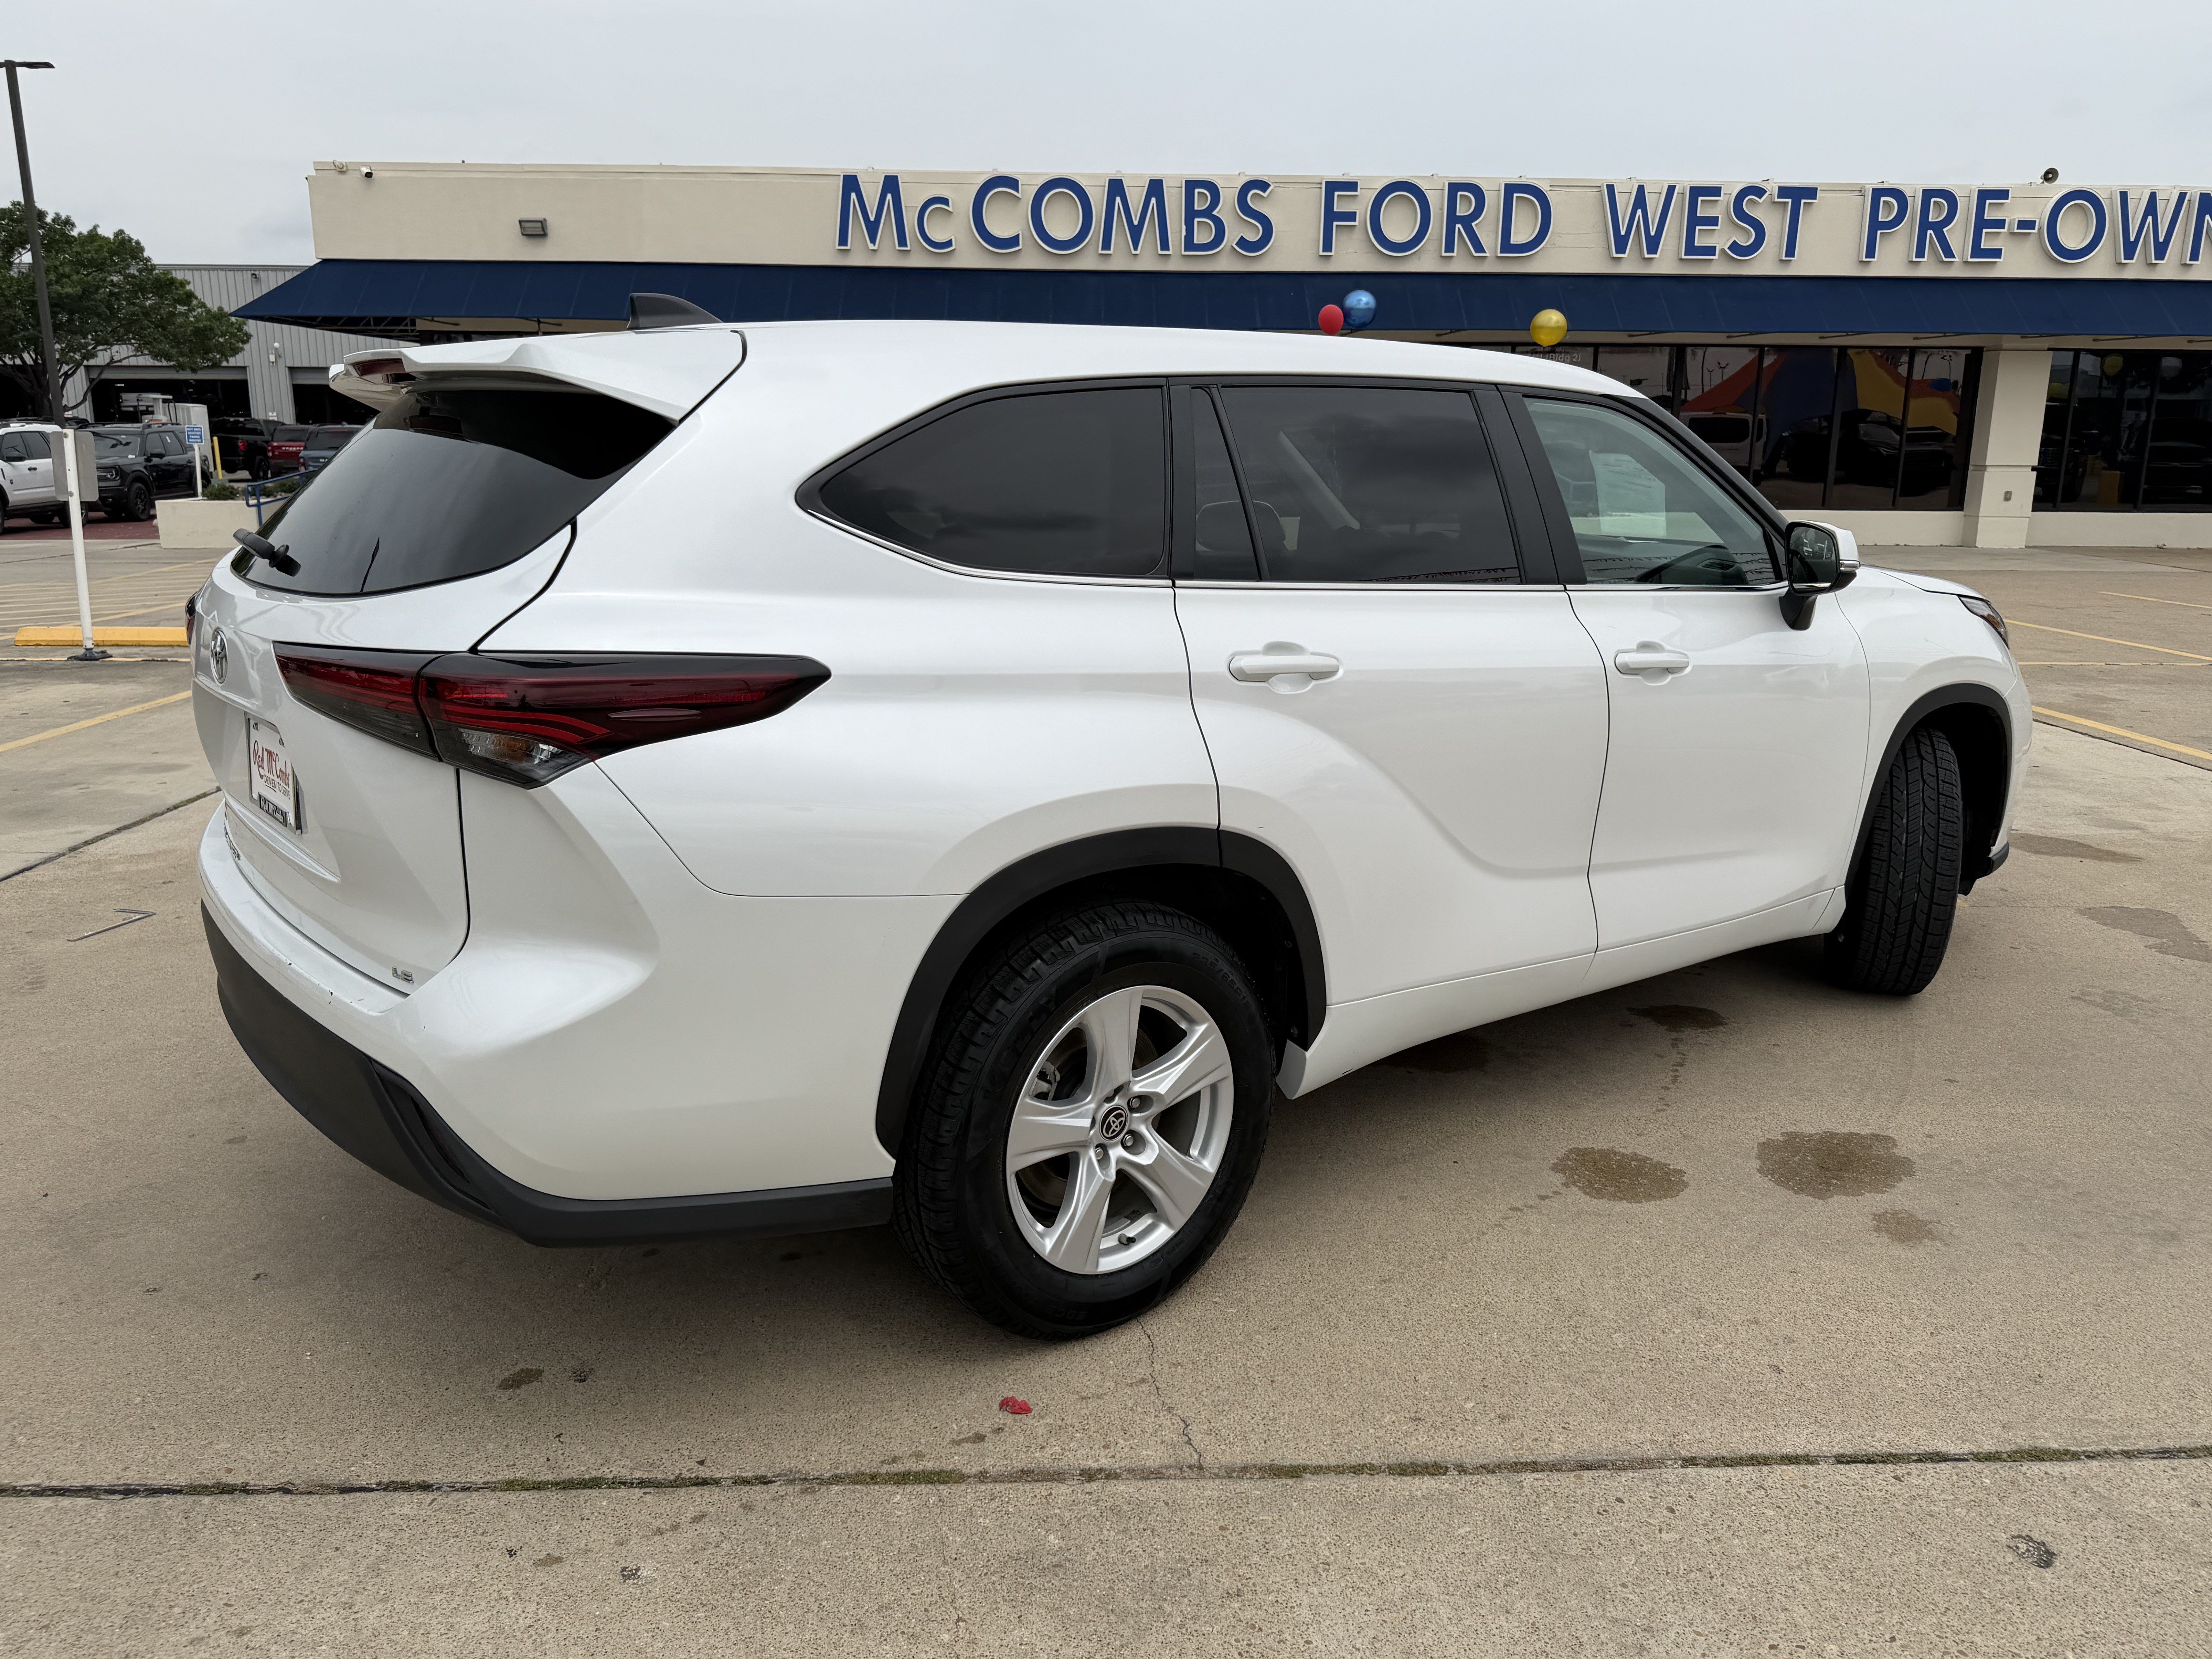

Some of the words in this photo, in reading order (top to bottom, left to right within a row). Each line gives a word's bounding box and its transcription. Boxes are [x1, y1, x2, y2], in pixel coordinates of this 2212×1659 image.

[1319, 178, 1553, 256] FORD
[1601, 182, 1819, 260] WEST
[253, 740, 265, 780] Red
[392, 966, 414, 984] LE
